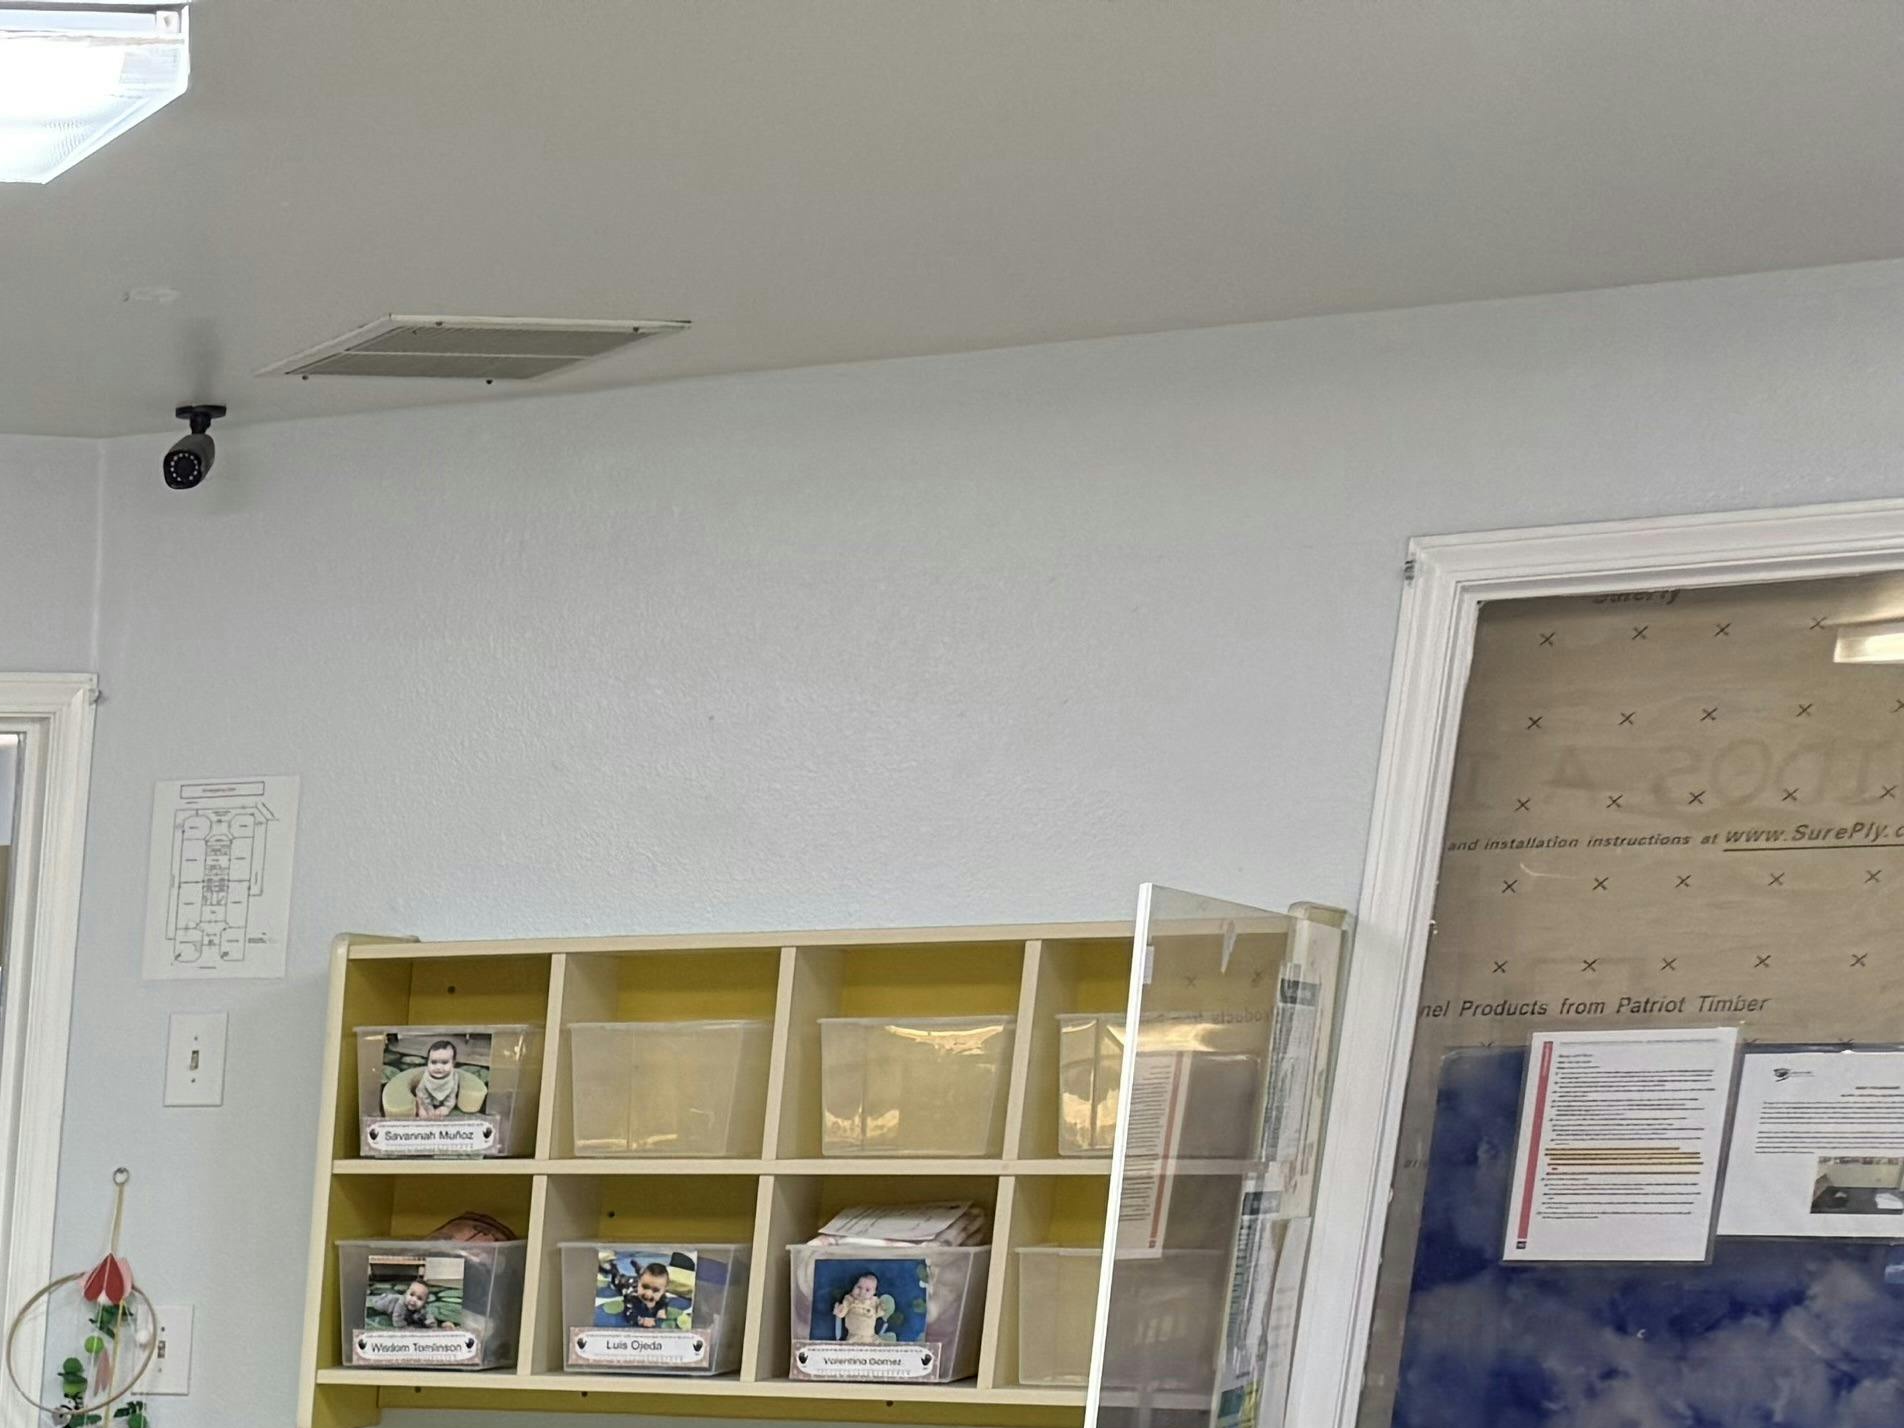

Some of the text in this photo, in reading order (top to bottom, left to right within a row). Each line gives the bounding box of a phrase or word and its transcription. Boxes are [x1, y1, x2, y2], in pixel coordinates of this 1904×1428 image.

[1447, 837, 1477, 852] and
[1484, 834, 1579, 850] installation
[1587, 833, 1690, 848] instructions
[1700, 833, 1719, 846] at
[1459, 999, 1547, 1018] Products
[1560, 998, 1605, 1015] from
[1616, 996, 1686, 1014] Patriot
[1699, 994, 1772, 1013] Timber
[384, 1130, 435, 1141] Savannah
[606, 1340, 662, 1352] Luis Ojeda
